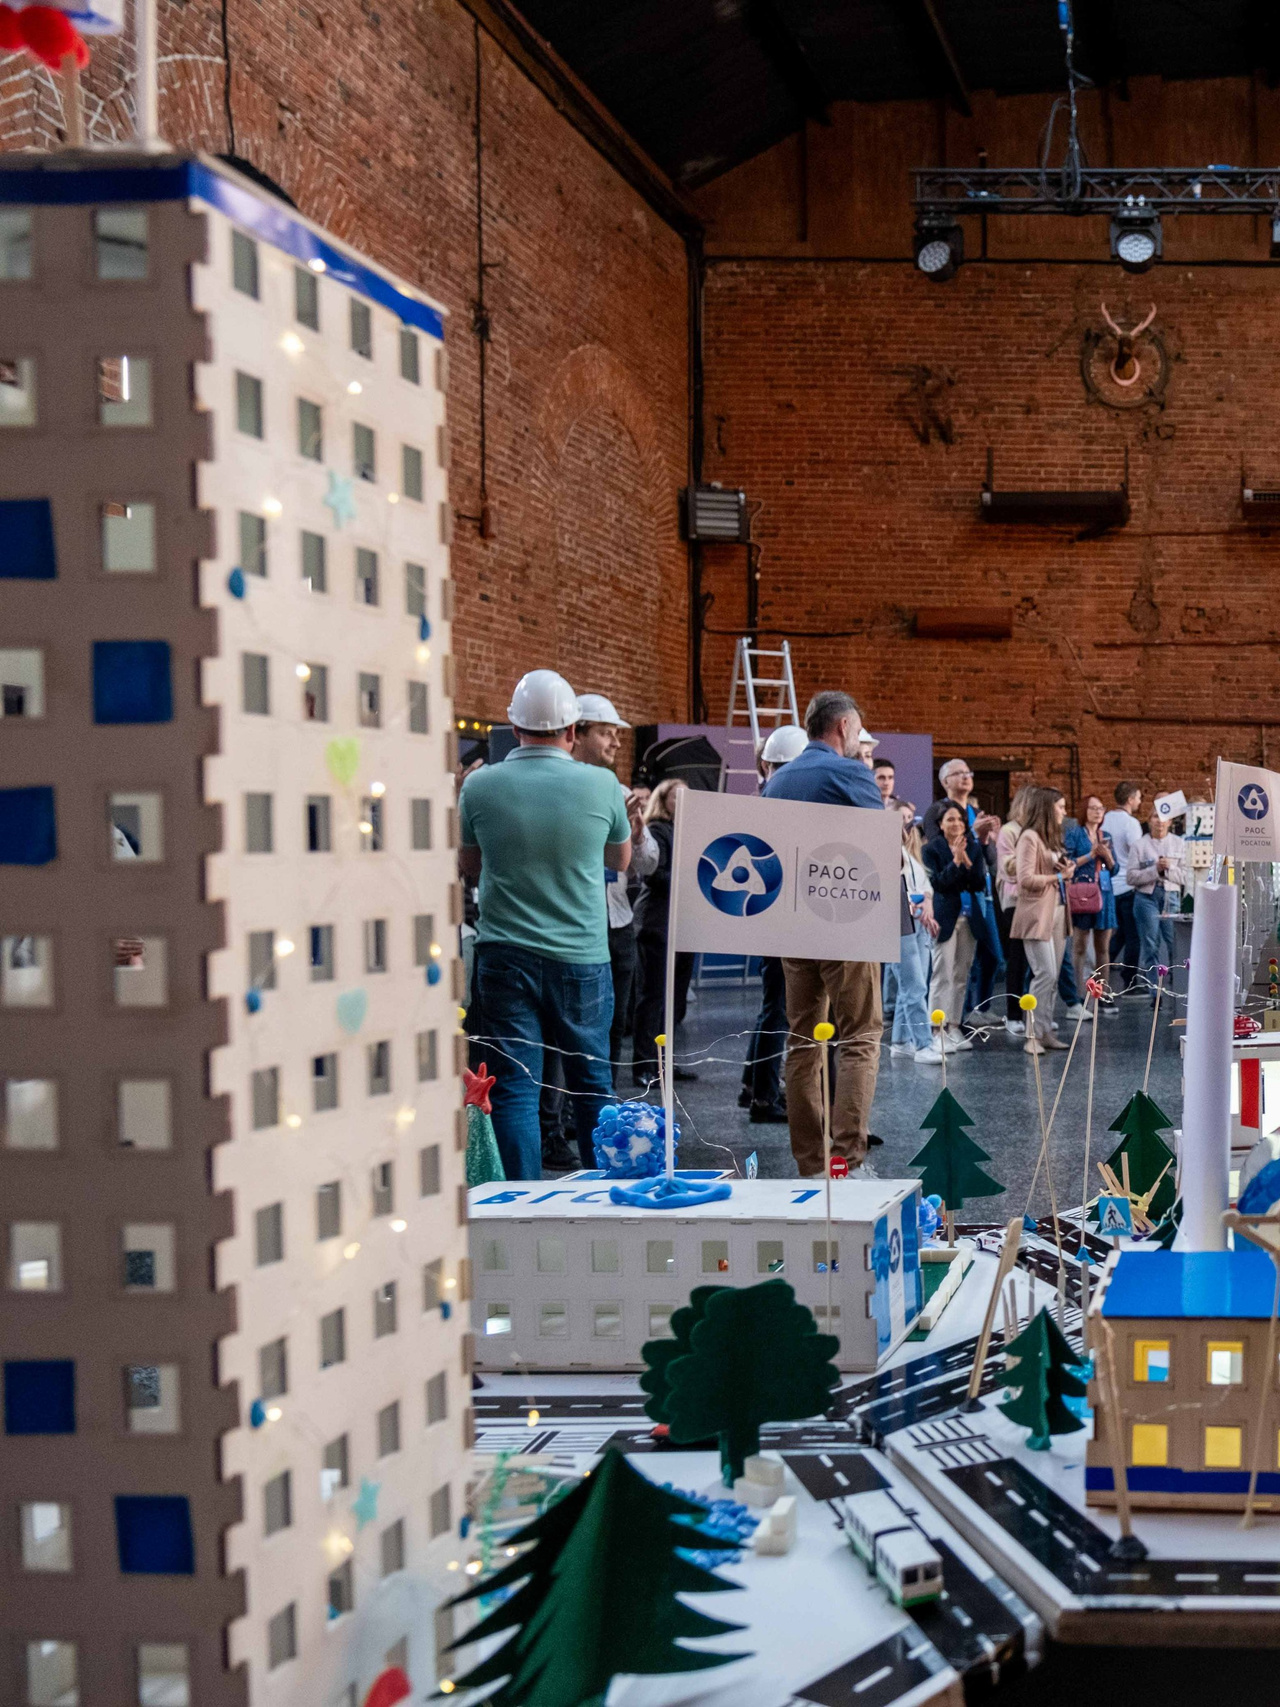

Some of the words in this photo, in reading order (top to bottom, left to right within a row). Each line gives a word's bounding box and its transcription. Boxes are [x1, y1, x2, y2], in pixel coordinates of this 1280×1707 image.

[1244, 826, 1266, 835] РАОС
[1240, 839, 1271, 847] РОСАТОМ
[808, 863, 858, 881] РАОС
[808, 885, 881, 901] РОСАТОМ
